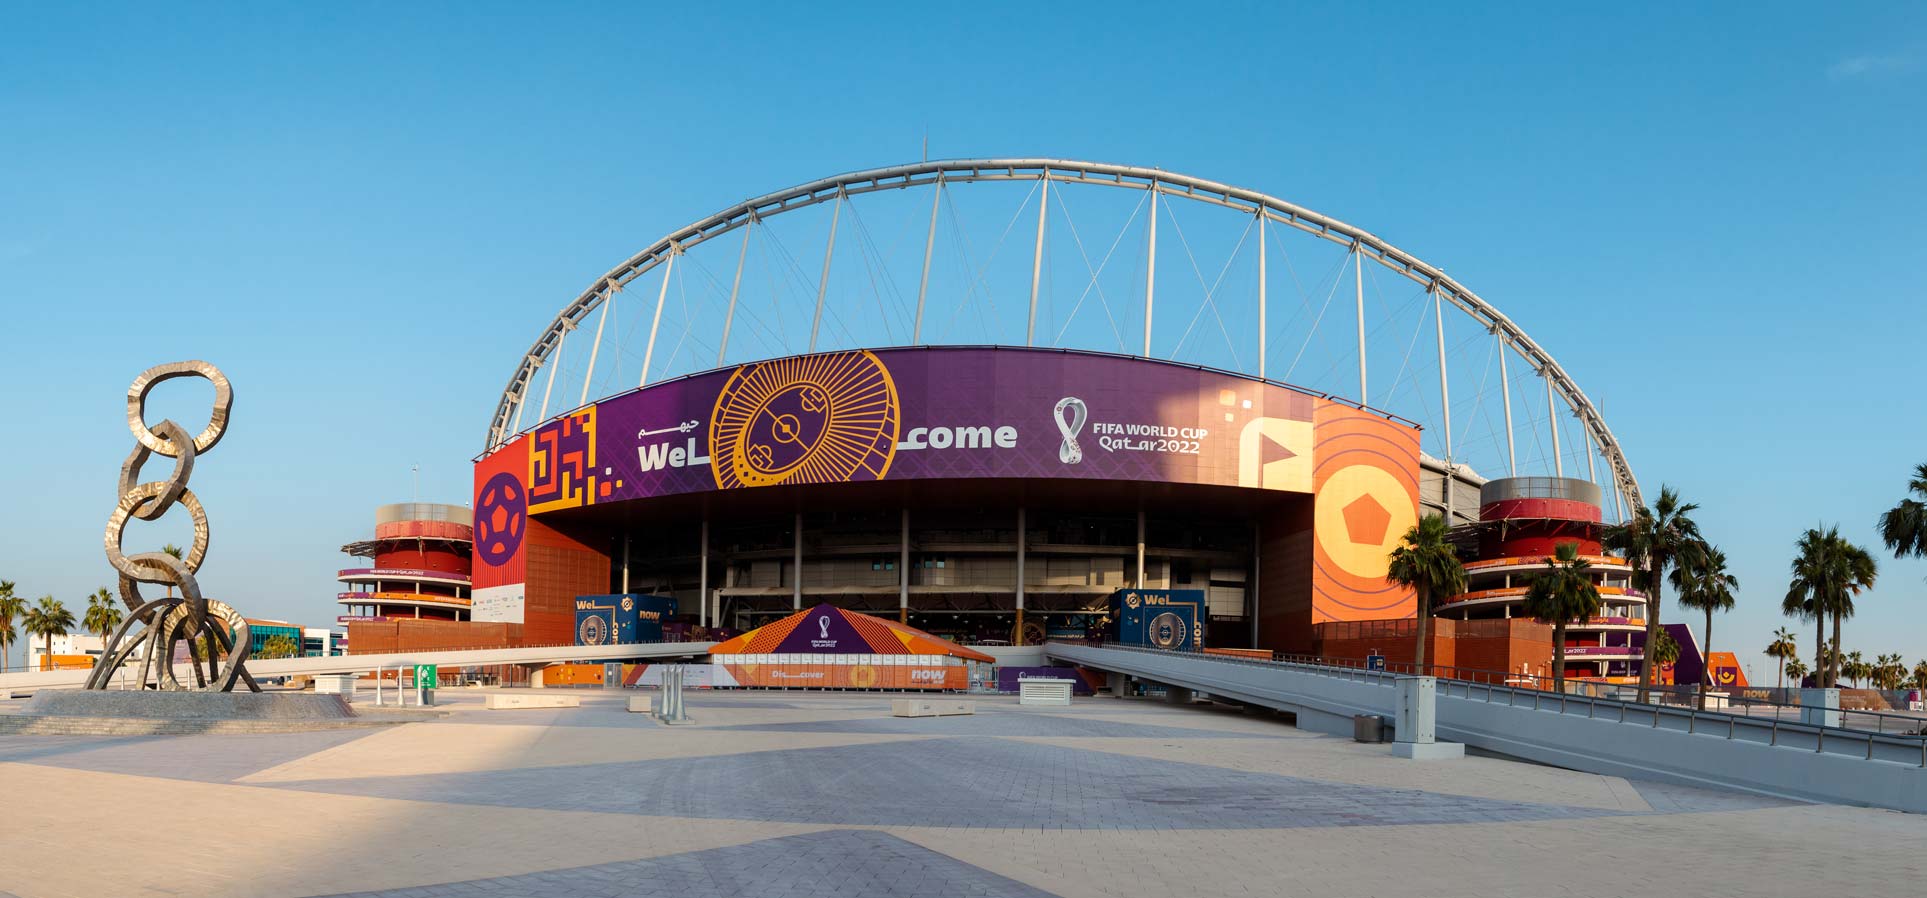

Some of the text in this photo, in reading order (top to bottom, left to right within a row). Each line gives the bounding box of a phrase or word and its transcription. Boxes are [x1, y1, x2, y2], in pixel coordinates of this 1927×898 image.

[1093, 423, 1208, 439] FIFA WORLD CUP
[640, 610, 660, 620] now
[912, 670, 945, 679] now
[1743, 690, 1770, 698] now
